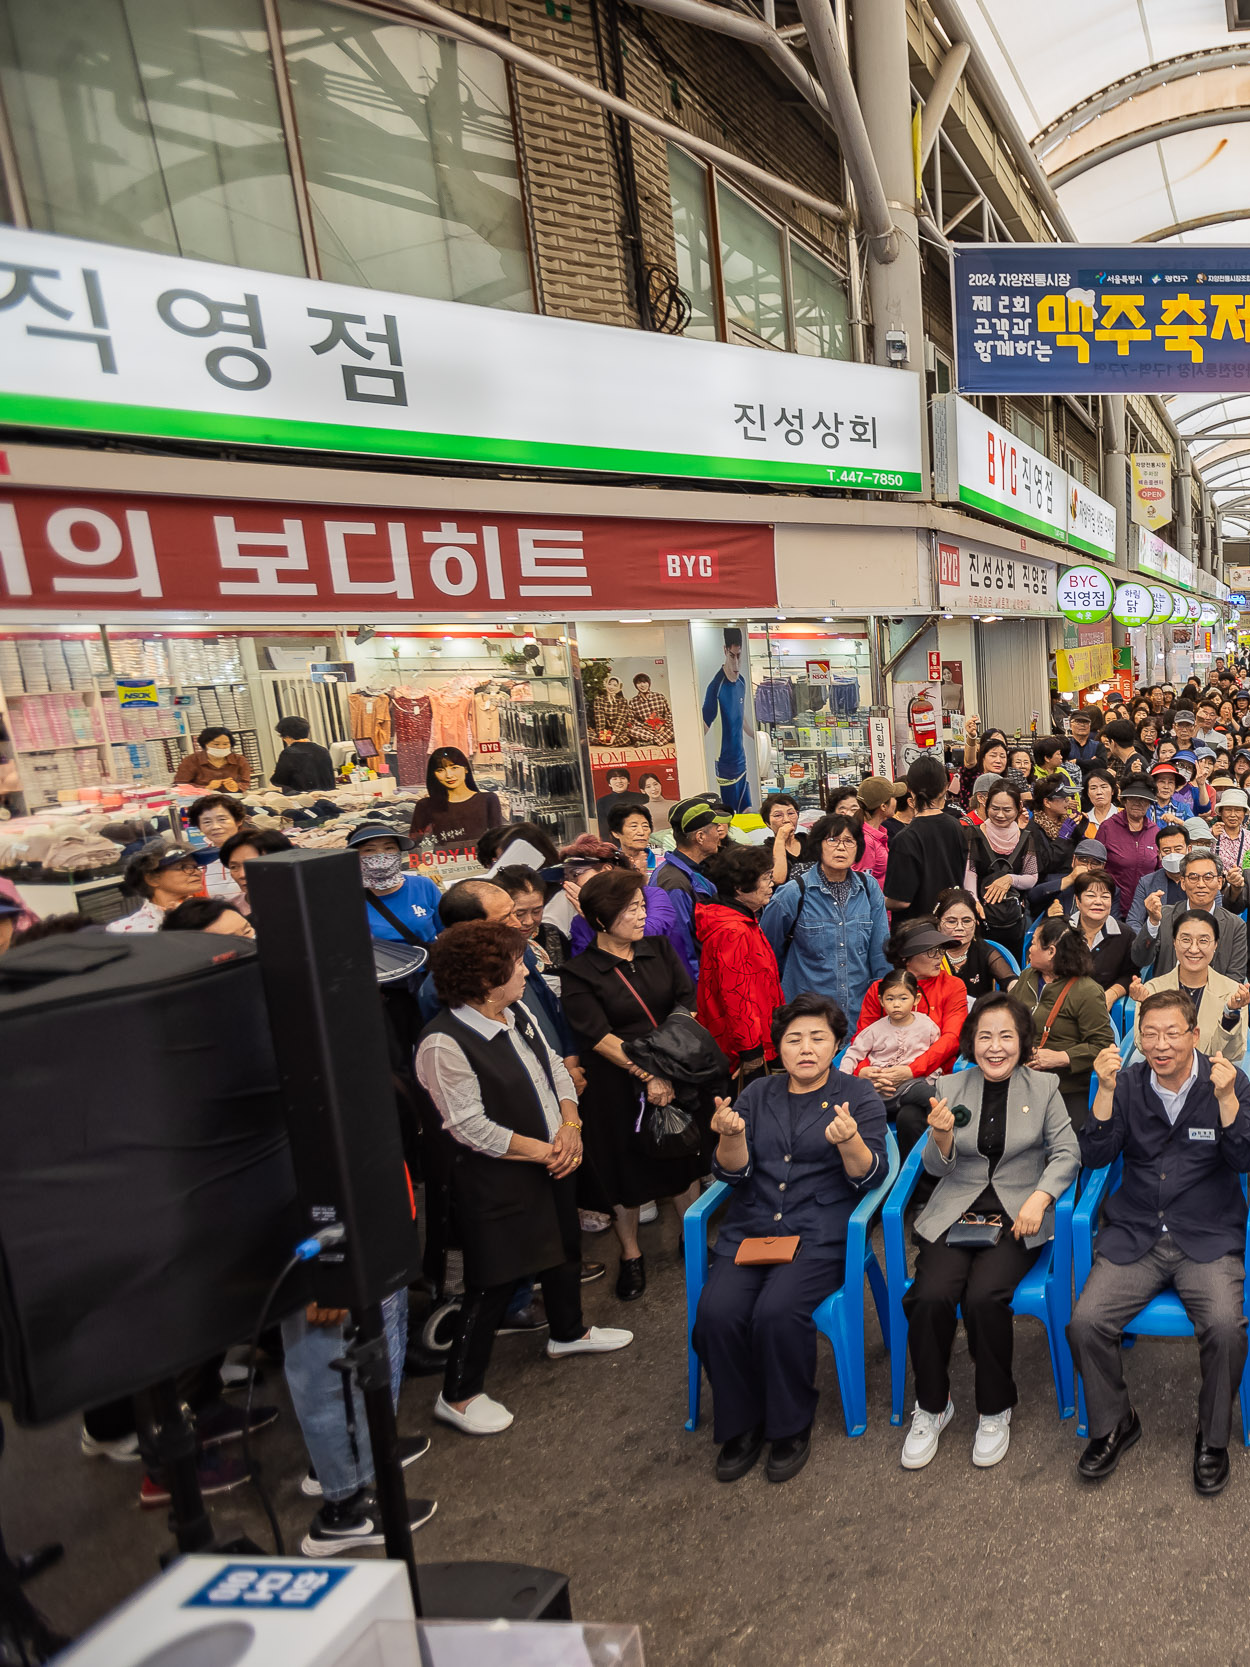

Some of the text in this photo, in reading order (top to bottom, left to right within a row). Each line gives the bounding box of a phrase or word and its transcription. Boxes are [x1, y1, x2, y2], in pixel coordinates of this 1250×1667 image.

[968, 273, 1071, 288] 2024 자양전통시장
[1106, 275, 1143, 284] 서울특별시
[1164, 275, 1188, 283] 광진구
[973, 318, 1032, 340] 고객과
[1037, 294, 1152, 364] 맥주
[973, 340, 1053, 363] 함께하는
[733, 402, 878, 450] 진성상회
[826, 468, 903, 486] T.447-7850
[988, 431, 1053, 515] BYC 직영점
[213, 515, 593, 600] 보디히트
[666, 554, 713, 579] BYC
[941, 551, 1048, 595] BYC 진성상회 직영점
[1069, 575, 1098, 588] BYC
[1063, 591, 1105, 608] 직영점
[1125, 589, 1141, 600] 하림
[1127, 599, 1138, 613] 닭
[481, 743, 499, 752] BYC
[590, 747, 677, 765] HOME WEAR
[409, 849, 459, 868] BODY
